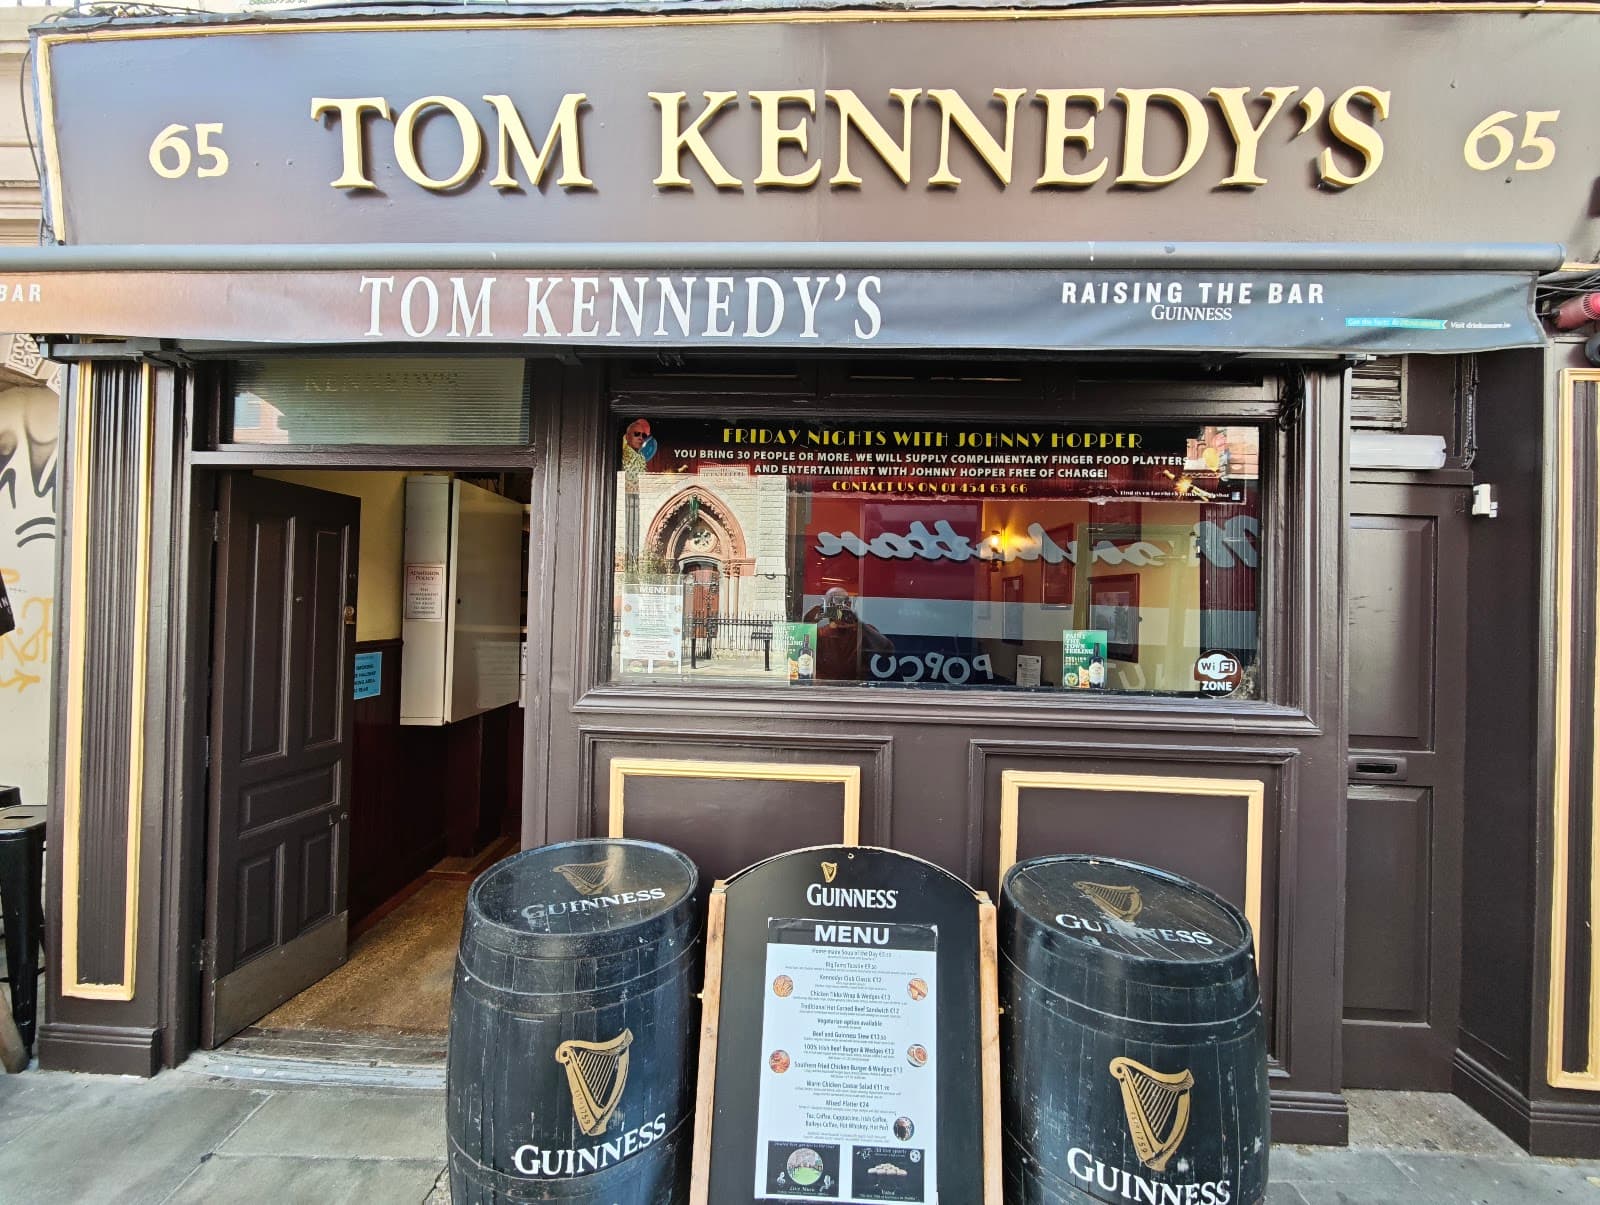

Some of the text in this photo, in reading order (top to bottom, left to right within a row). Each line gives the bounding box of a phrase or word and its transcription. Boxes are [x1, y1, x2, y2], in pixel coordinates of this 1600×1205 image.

[311, 84, 1392, 191] TOM KENNEDY'S
[1463, 109, 1561, 172] 65
[148, 122, 229, 179] 65
[0, 283, 42, 303] BAR
[1061, 281, 1325, 306] RAISING THE BAR
[359, 274, 883, 341] TOM KENNEDY'S
[1151, 304, 1233, 322] GUINNESS
[723, 428, 1143, 449] FRIDAY NIGHTS WITH JOHNNY HOPPER
[674, 449, 1189, 466] YOU BRING 30 PEOPLE OR MORE. WE WILL SUPPLY COMPLIMENTARY FINGER FOOD PLATTERS
[754, 464, 779, 474] AND
[781, 465, 875, 476] ENTERTAINMENT
[878, 466, 907, 476] WITH
[909, 467, 957, 477] JOHNNY
[960, 467, 1006, 478] HOPPER
[1008, 468, 1037, 477] FREE
[1039, 469, 1055, 477] OF
[1057, 469, 1108, 478] CHARGE!
[832, 481, 1028, 494] CONTACT US ON 01 454 63 66
[640, 586, 668, 594] MENU
[1201, 680, 1233, 692] ZONE
[521, 887, 666, 921] GUINNESS
[806, 883, 899, 909] GUINNESS
[814, 924, 890, 945] MENU
[1055, 913, 1214, 945] GUINESS
[860, 1019, 883, 1027] available
[804, 1043, 817, 1051] 100%
[850, 1064, 868, 1073] Burger
[872, 1065, 893, 1074] Wedges
[513, 1112, 668, 1177] GUINNESS
[1066, 1146, 1232, 1205] GUINNESS
